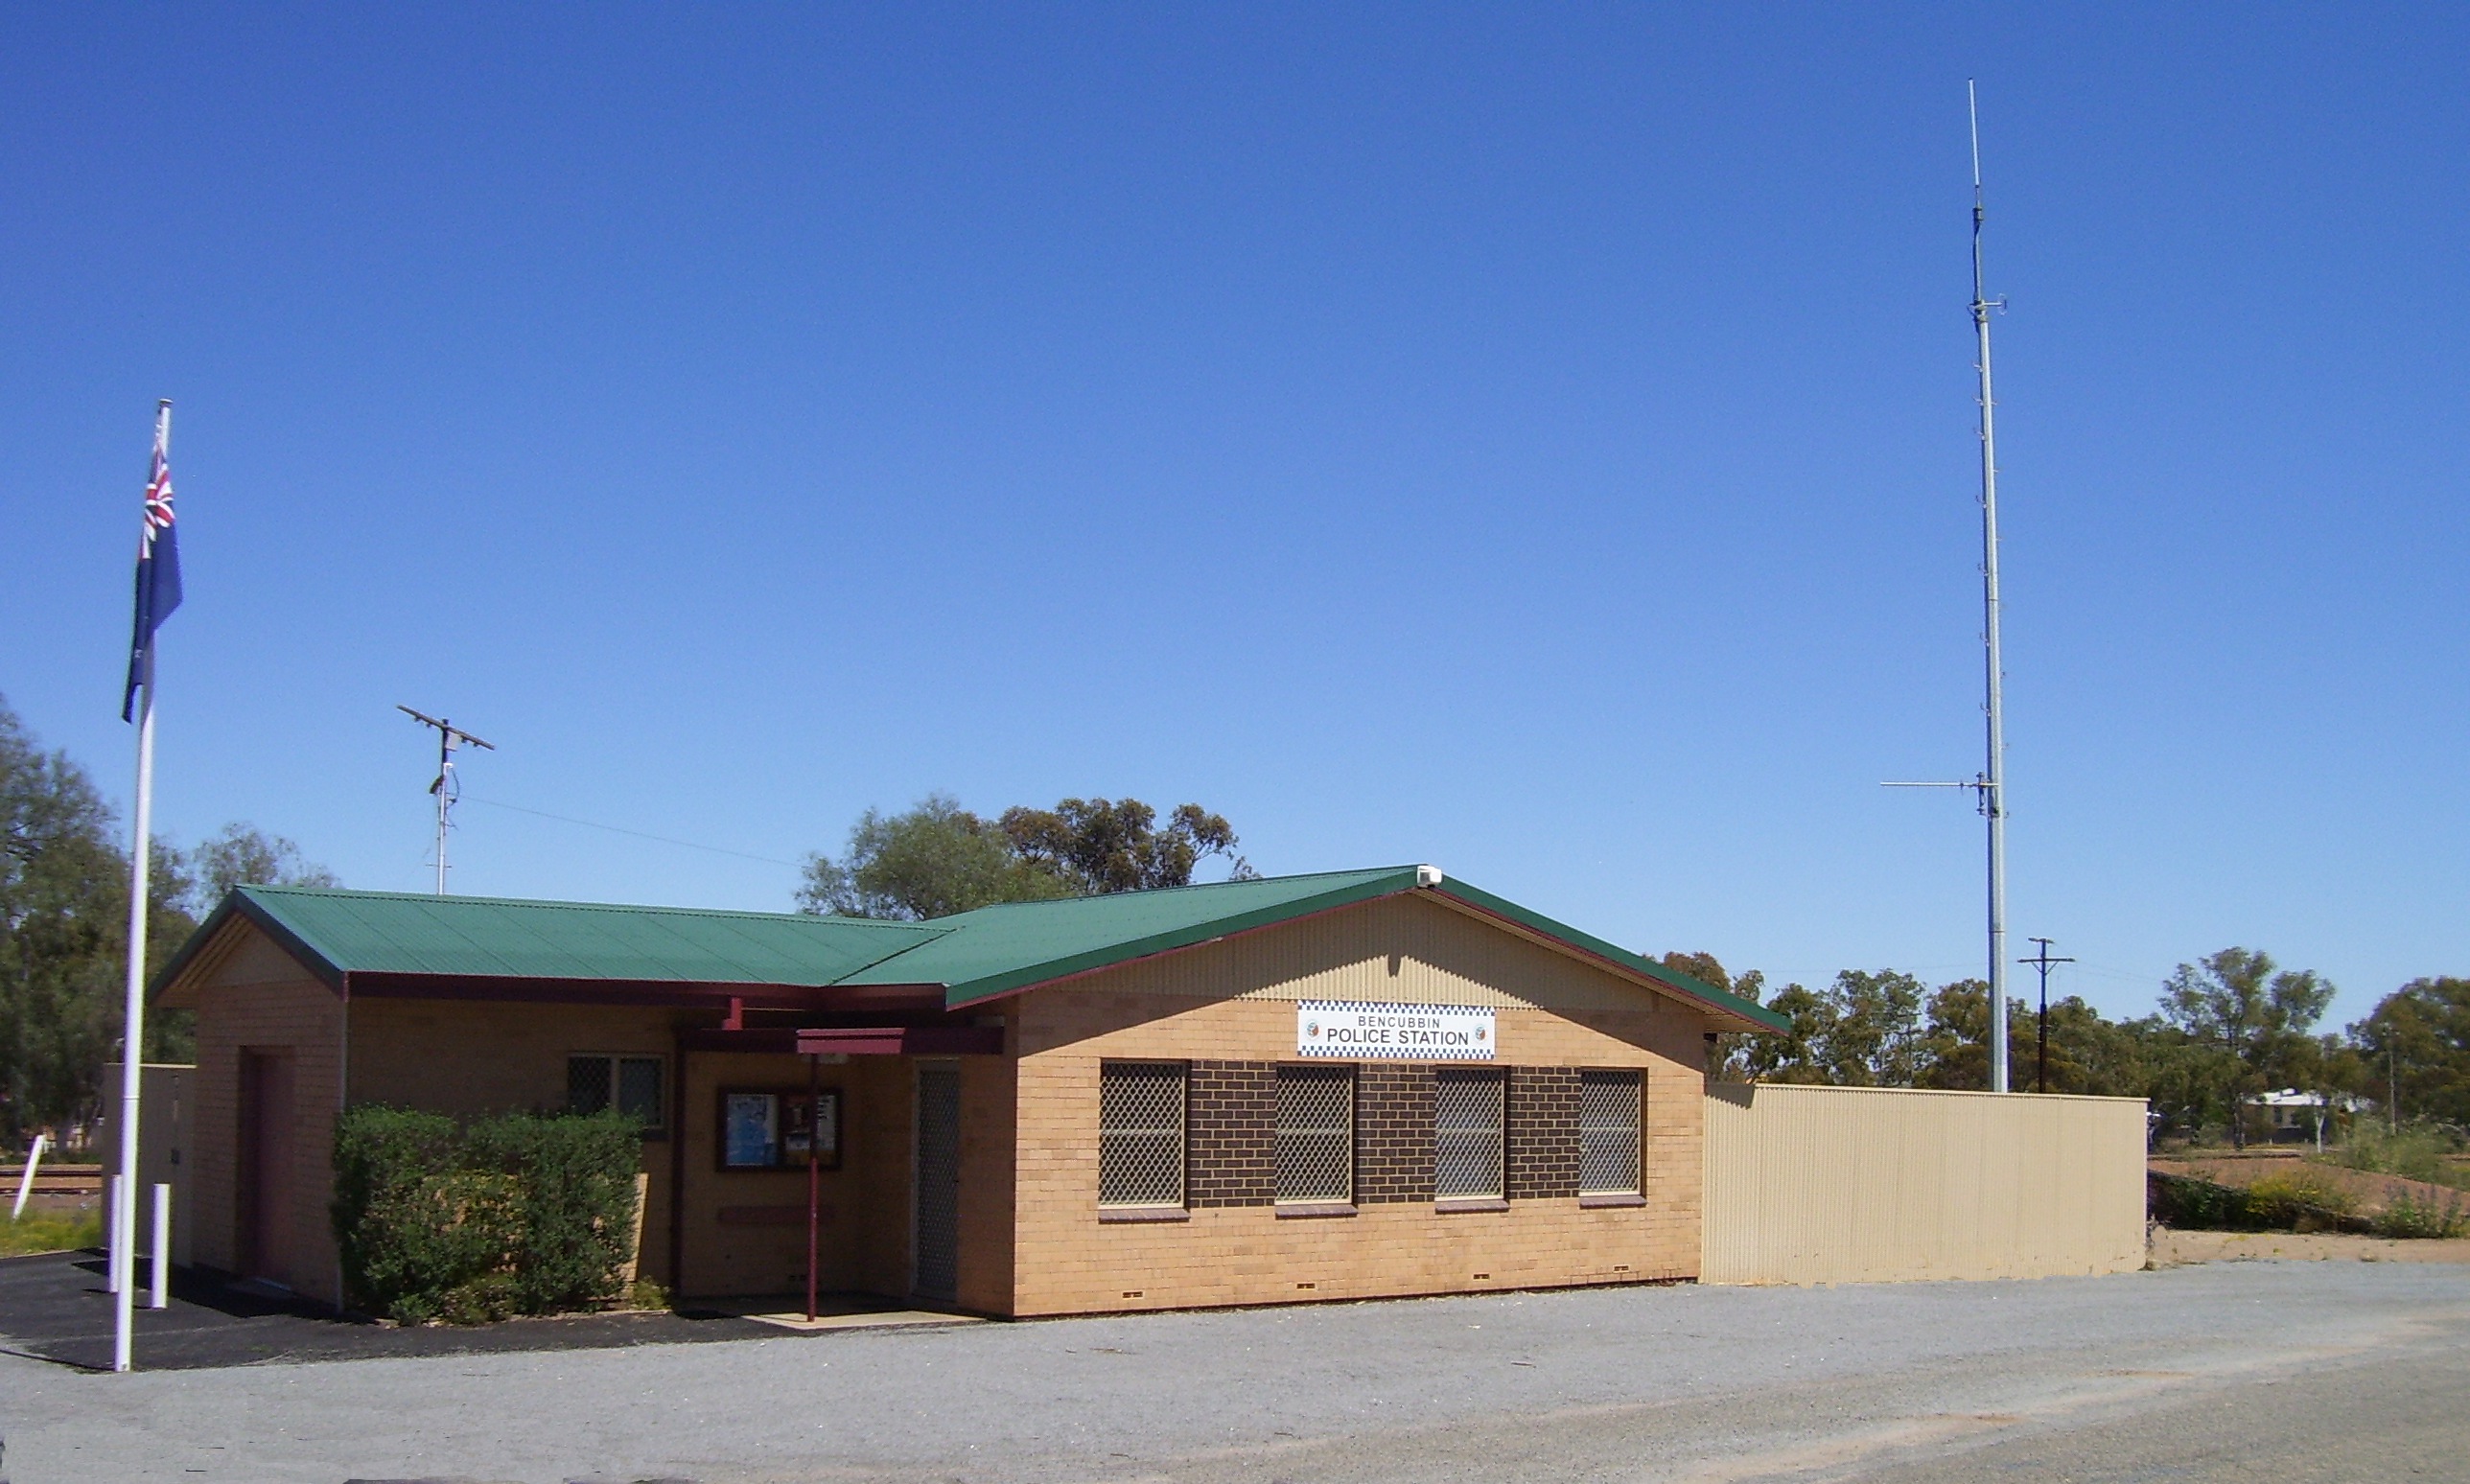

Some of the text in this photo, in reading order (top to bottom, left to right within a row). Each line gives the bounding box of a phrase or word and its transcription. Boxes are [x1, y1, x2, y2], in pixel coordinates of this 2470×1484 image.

[1358, 1016, 1440, 1029] BENCUBBIN
[1327, 1029, 1468, 1046] POLICE STATION
